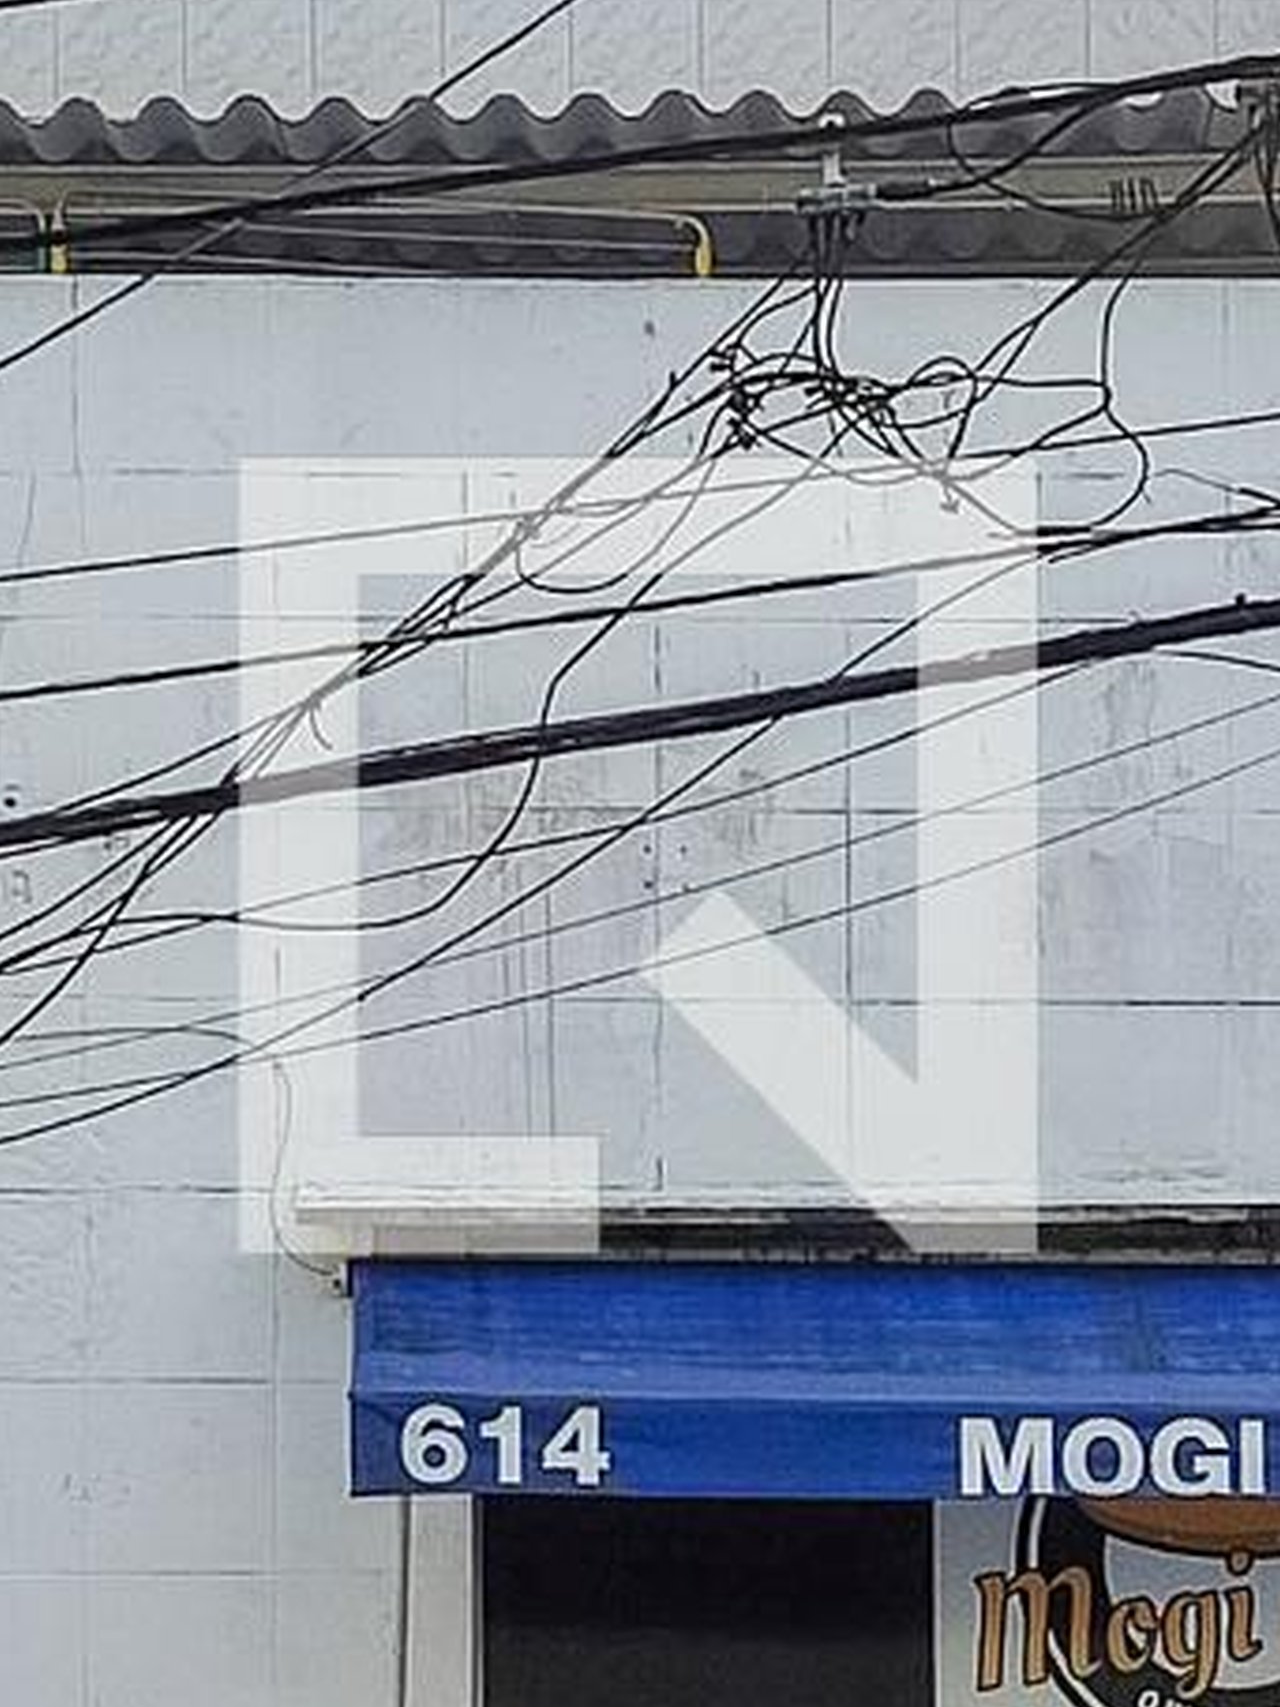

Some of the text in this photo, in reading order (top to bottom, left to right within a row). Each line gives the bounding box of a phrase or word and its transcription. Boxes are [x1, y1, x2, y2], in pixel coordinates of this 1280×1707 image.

[401, 1402, 611, 1485] 614
[958, 1416, 1266, 1497] MOGI
[974, 1549, 1264, 1702] Mogi
